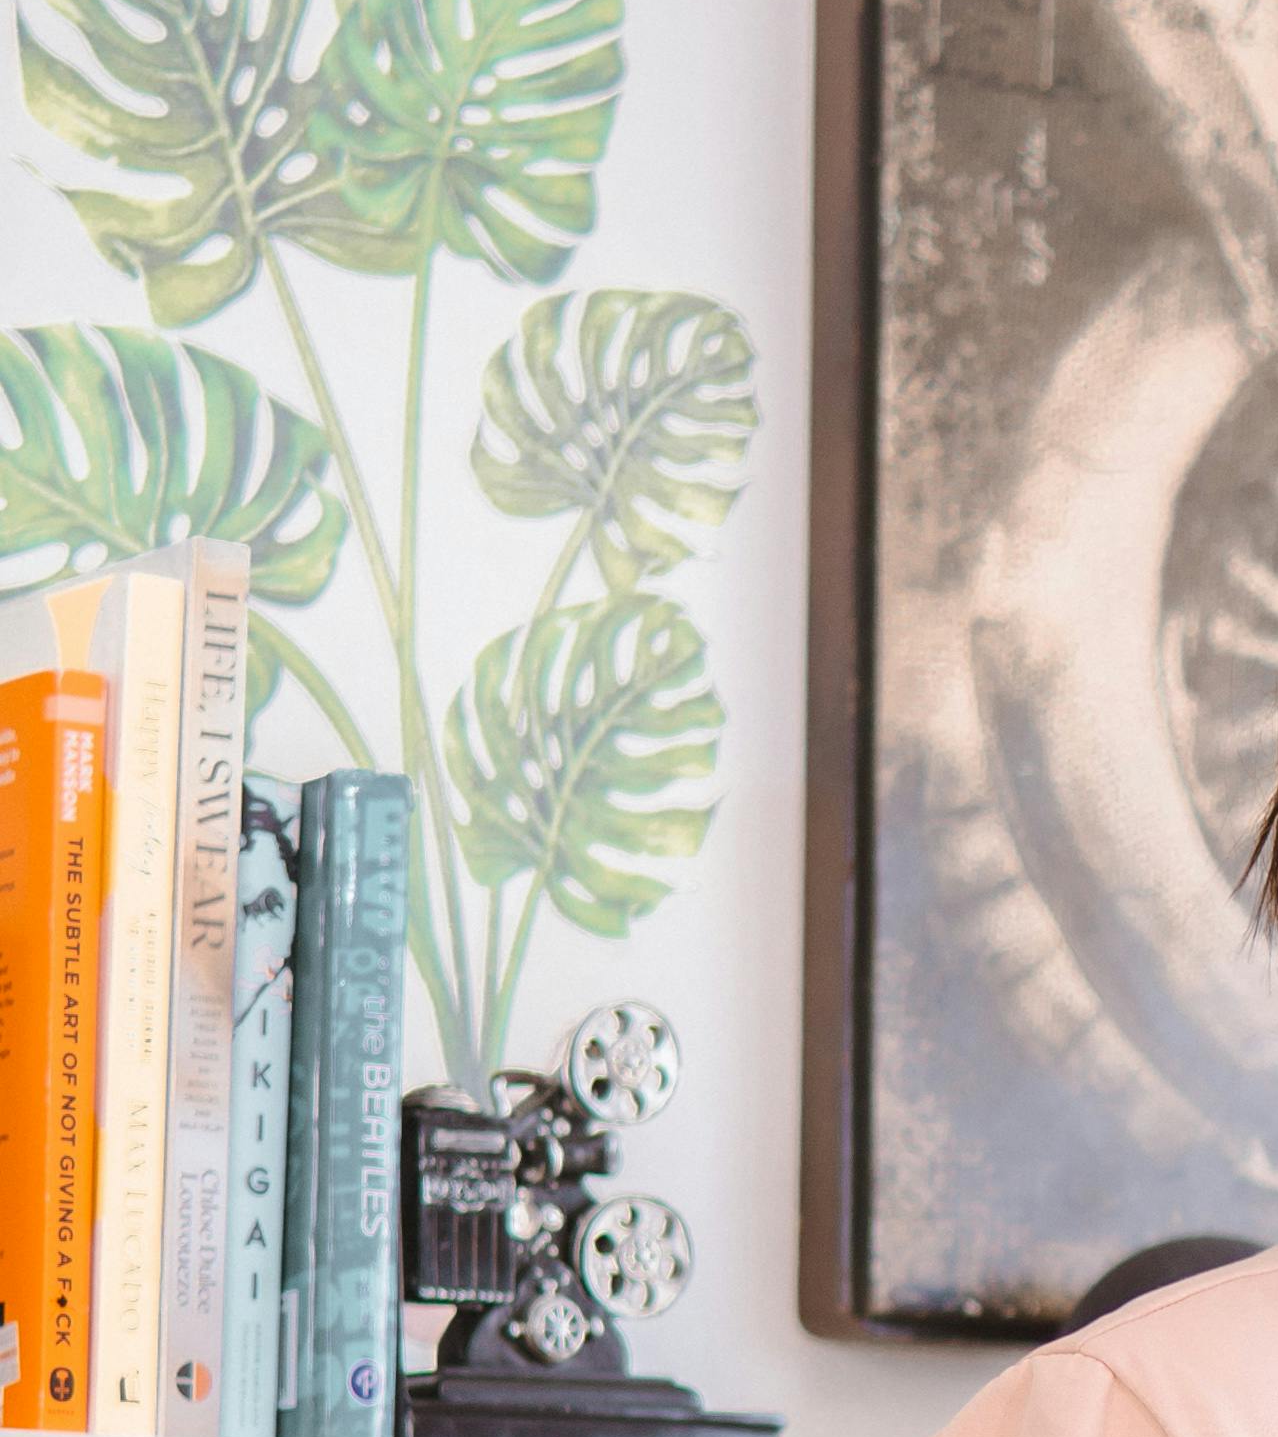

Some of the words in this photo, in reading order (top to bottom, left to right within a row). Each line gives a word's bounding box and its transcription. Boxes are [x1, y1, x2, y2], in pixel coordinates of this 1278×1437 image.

[197, 590, 240, 712] LIFE,
[78, 731, 94, 793] MARK
[200, 731, 233, 741] I
[60, 729, 79, 823] MANSON
[67, 837, 84, 884] THE
[191, 756, 233, 949] SWEAR
[64, 892, 82, 986] SUBTLE
[63, 994, 79, 1044] ART
[362, 995, 390, 1056] the
[62, 1052, 78, 1087] OF
[60, 1094, 76, 1147] NOT
[361, 1062, 392, 1237] BEATLES
[244, 1008, 272, 1301] IKIGAI
[57, 1155, 75, 1242] GIVING
[57, 1251, 73, 1268] A
[55, 1277, 73, 1346] FCK
